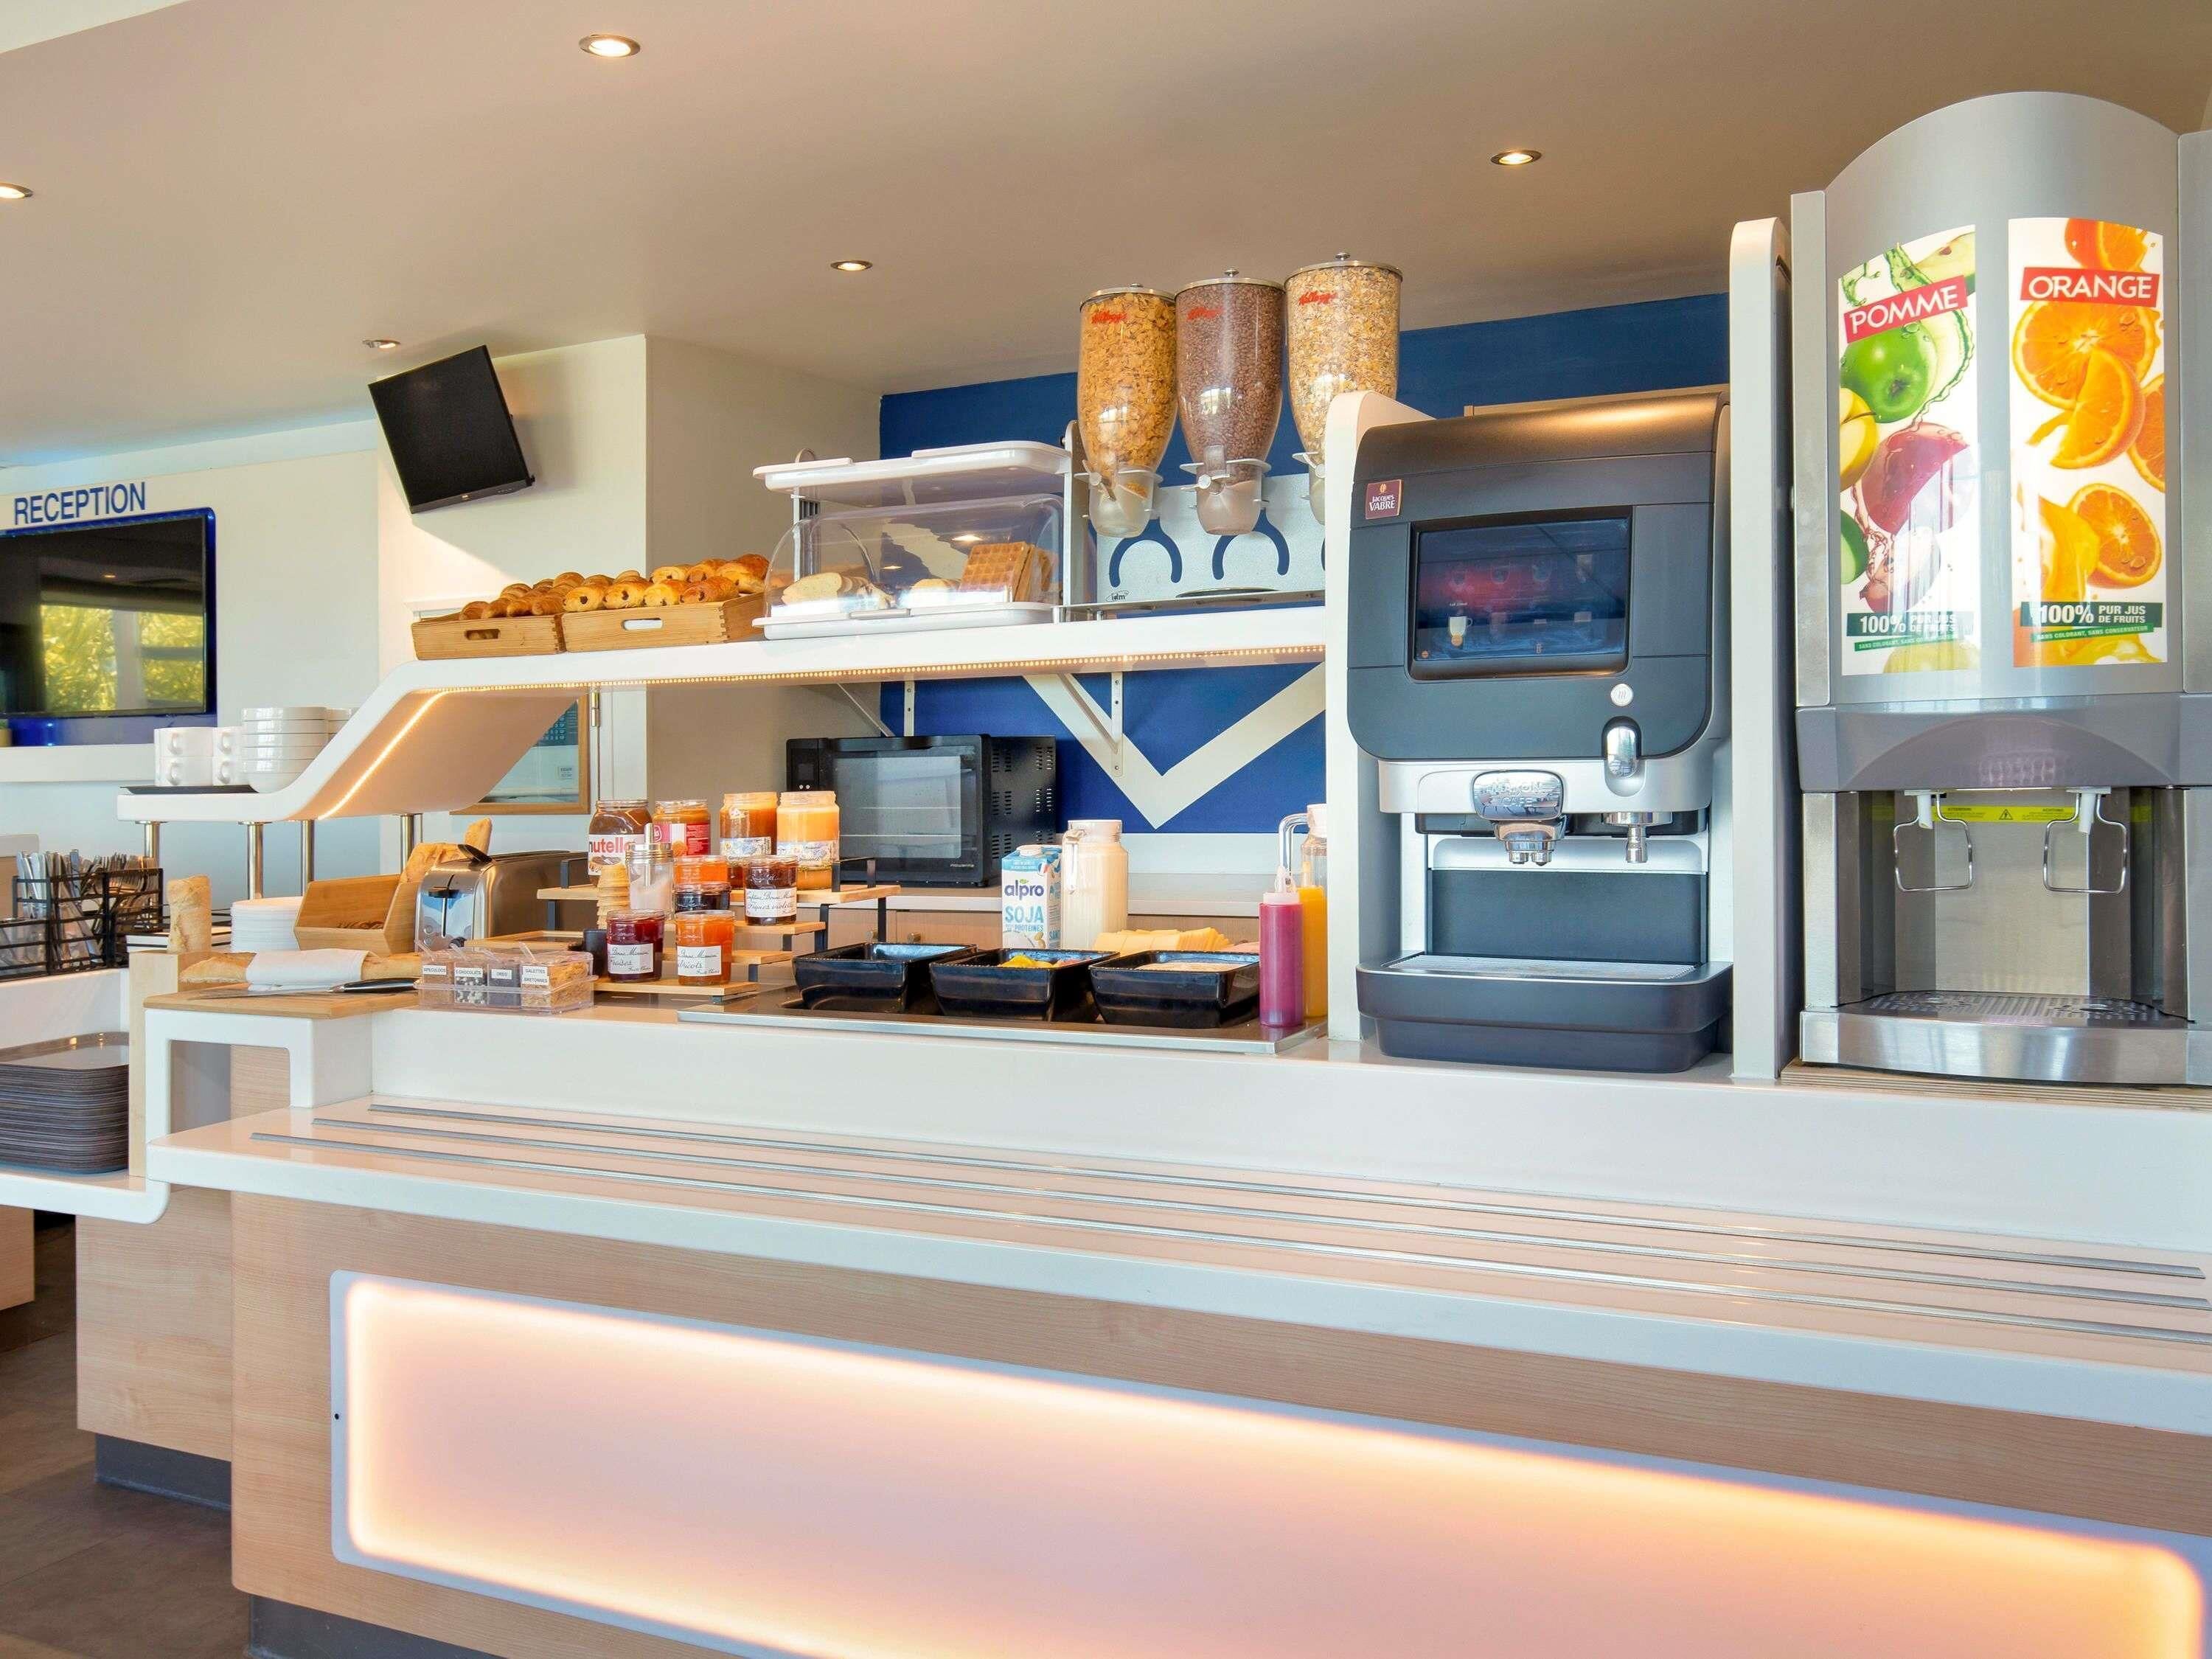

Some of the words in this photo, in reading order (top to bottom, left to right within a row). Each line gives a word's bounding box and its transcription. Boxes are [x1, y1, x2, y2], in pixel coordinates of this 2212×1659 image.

[2028, 274, 2153, 299] ORANGE
[1849, 285, 1959, 335] POMME
[14, 481, 145, 525] RECEPTION
[1369, 500, 1395, 512] VABRE
[1371, 494, 1395, 504] Jacques
[2039, 605, 2094, 624] 100%
[2098, 605, 2121, 615] PUR
[2124, 605, 2146, 615] JUS
[1860, 615, 1907, 633] 100%
[1910, 614, 1931, 625] PUR
[1910, 624, 1923, 633] DE
[2098, 615, 2111, 624] DE
[2113, 615, 2146, 624] FRUITS
[1004, 880, 1045, 900] alpro
[1005, 905, 1044, 923] SOJA
